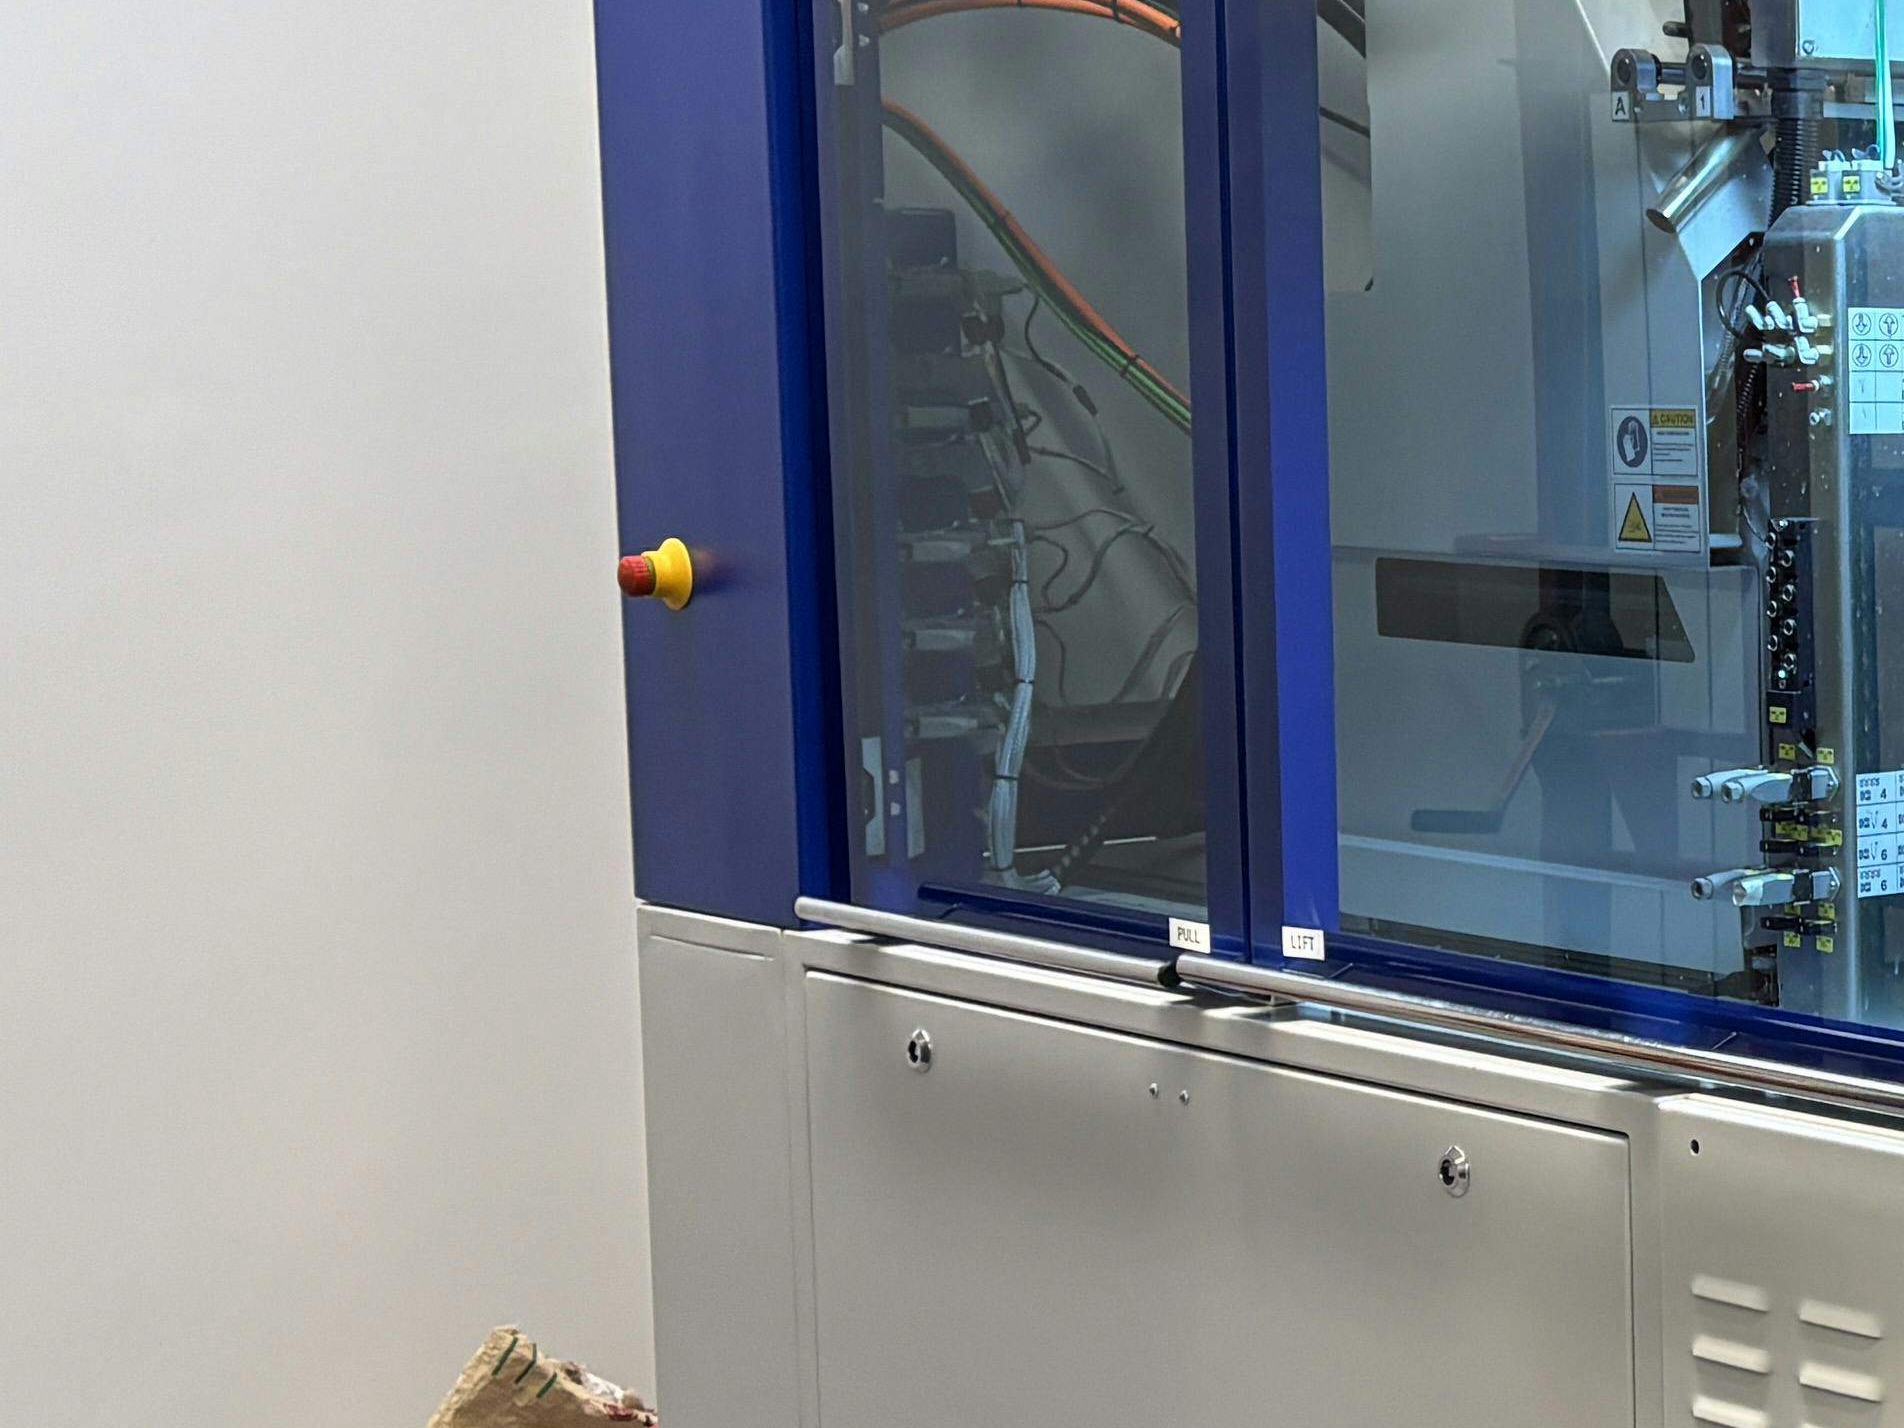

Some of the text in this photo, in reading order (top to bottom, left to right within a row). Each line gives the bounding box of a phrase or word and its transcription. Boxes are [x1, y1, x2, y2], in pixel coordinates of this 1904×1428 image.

[1615, 96, 1626, 115] A
[1699, 97, 1705, 110] 1
[1177, 926, 1200, 944] PULL
[1290, 934, 1314, 951] LIFT
